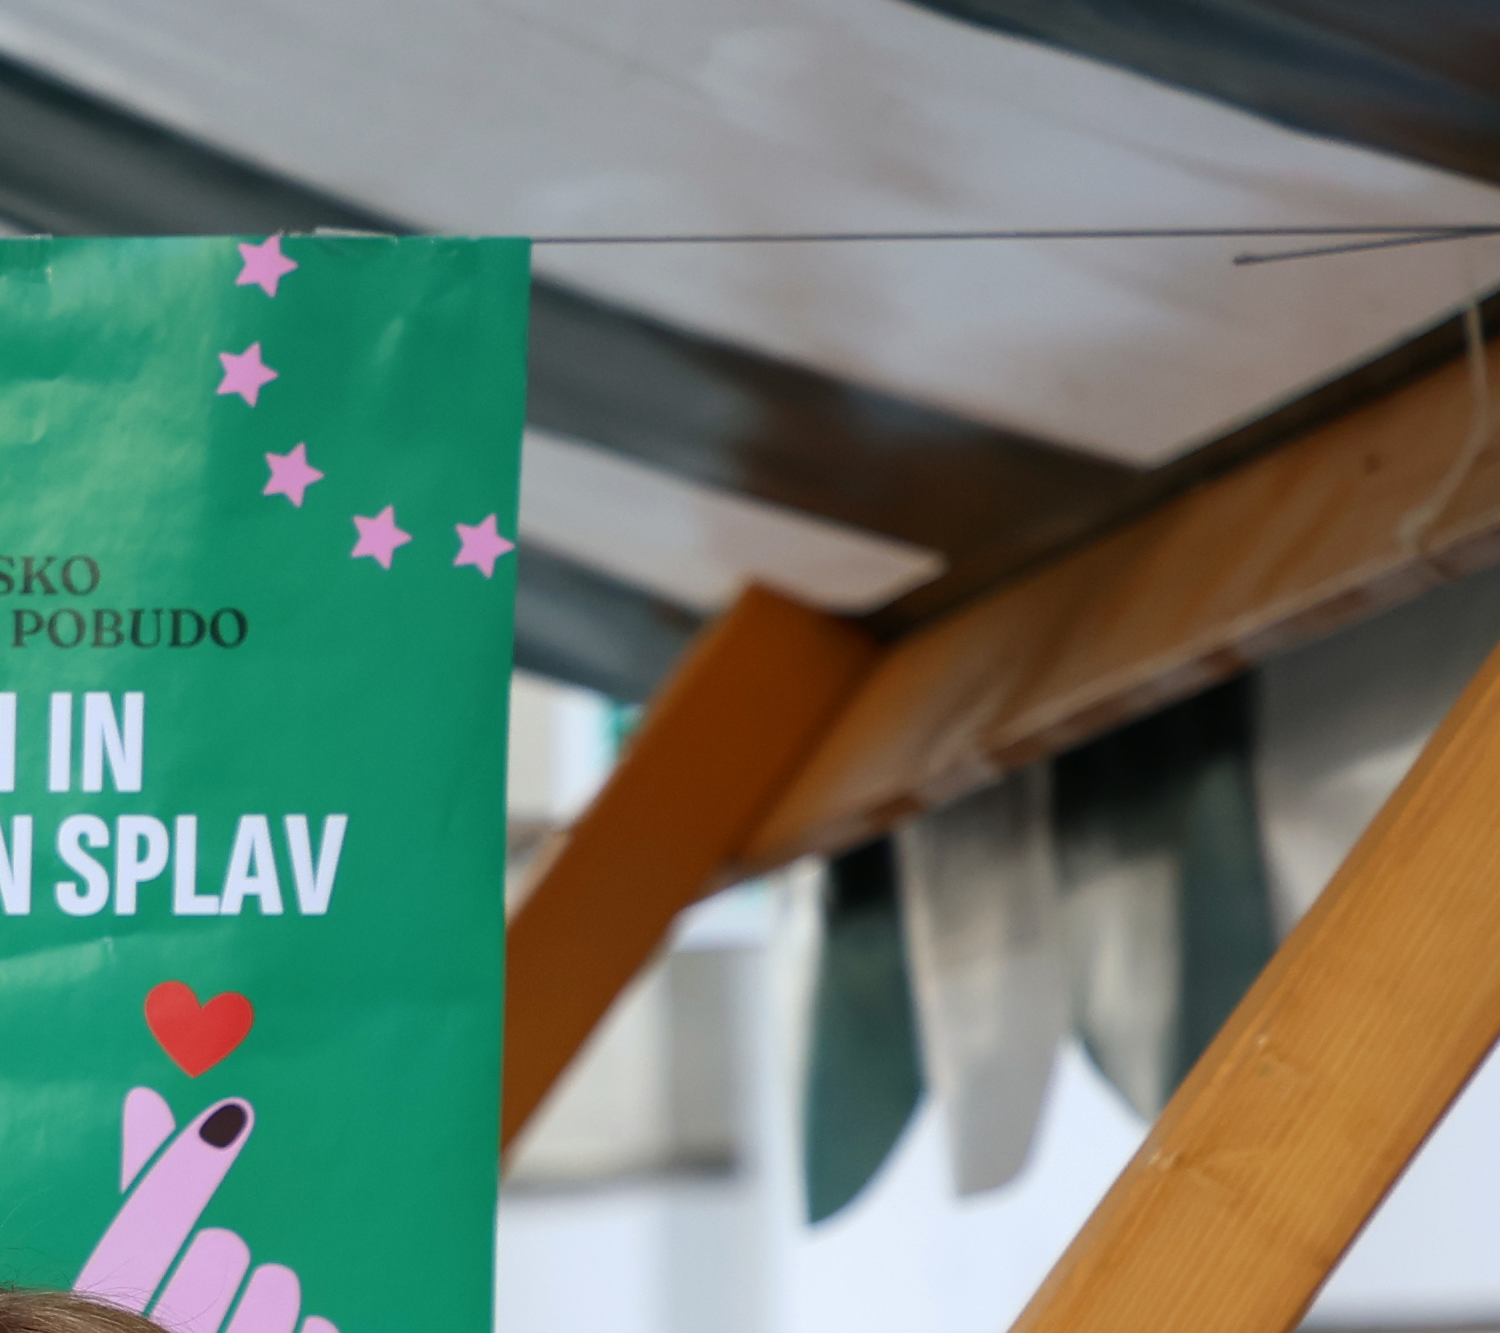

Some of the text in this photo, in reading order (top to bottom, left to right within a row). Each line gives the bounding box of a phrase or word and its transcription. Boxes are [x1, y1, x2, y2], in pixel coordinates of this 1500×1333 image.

[11, 608, 250, 649] POBUDO
[47, 692, 145, 792] IN
[55, 813, 348, 916] SPLAV
